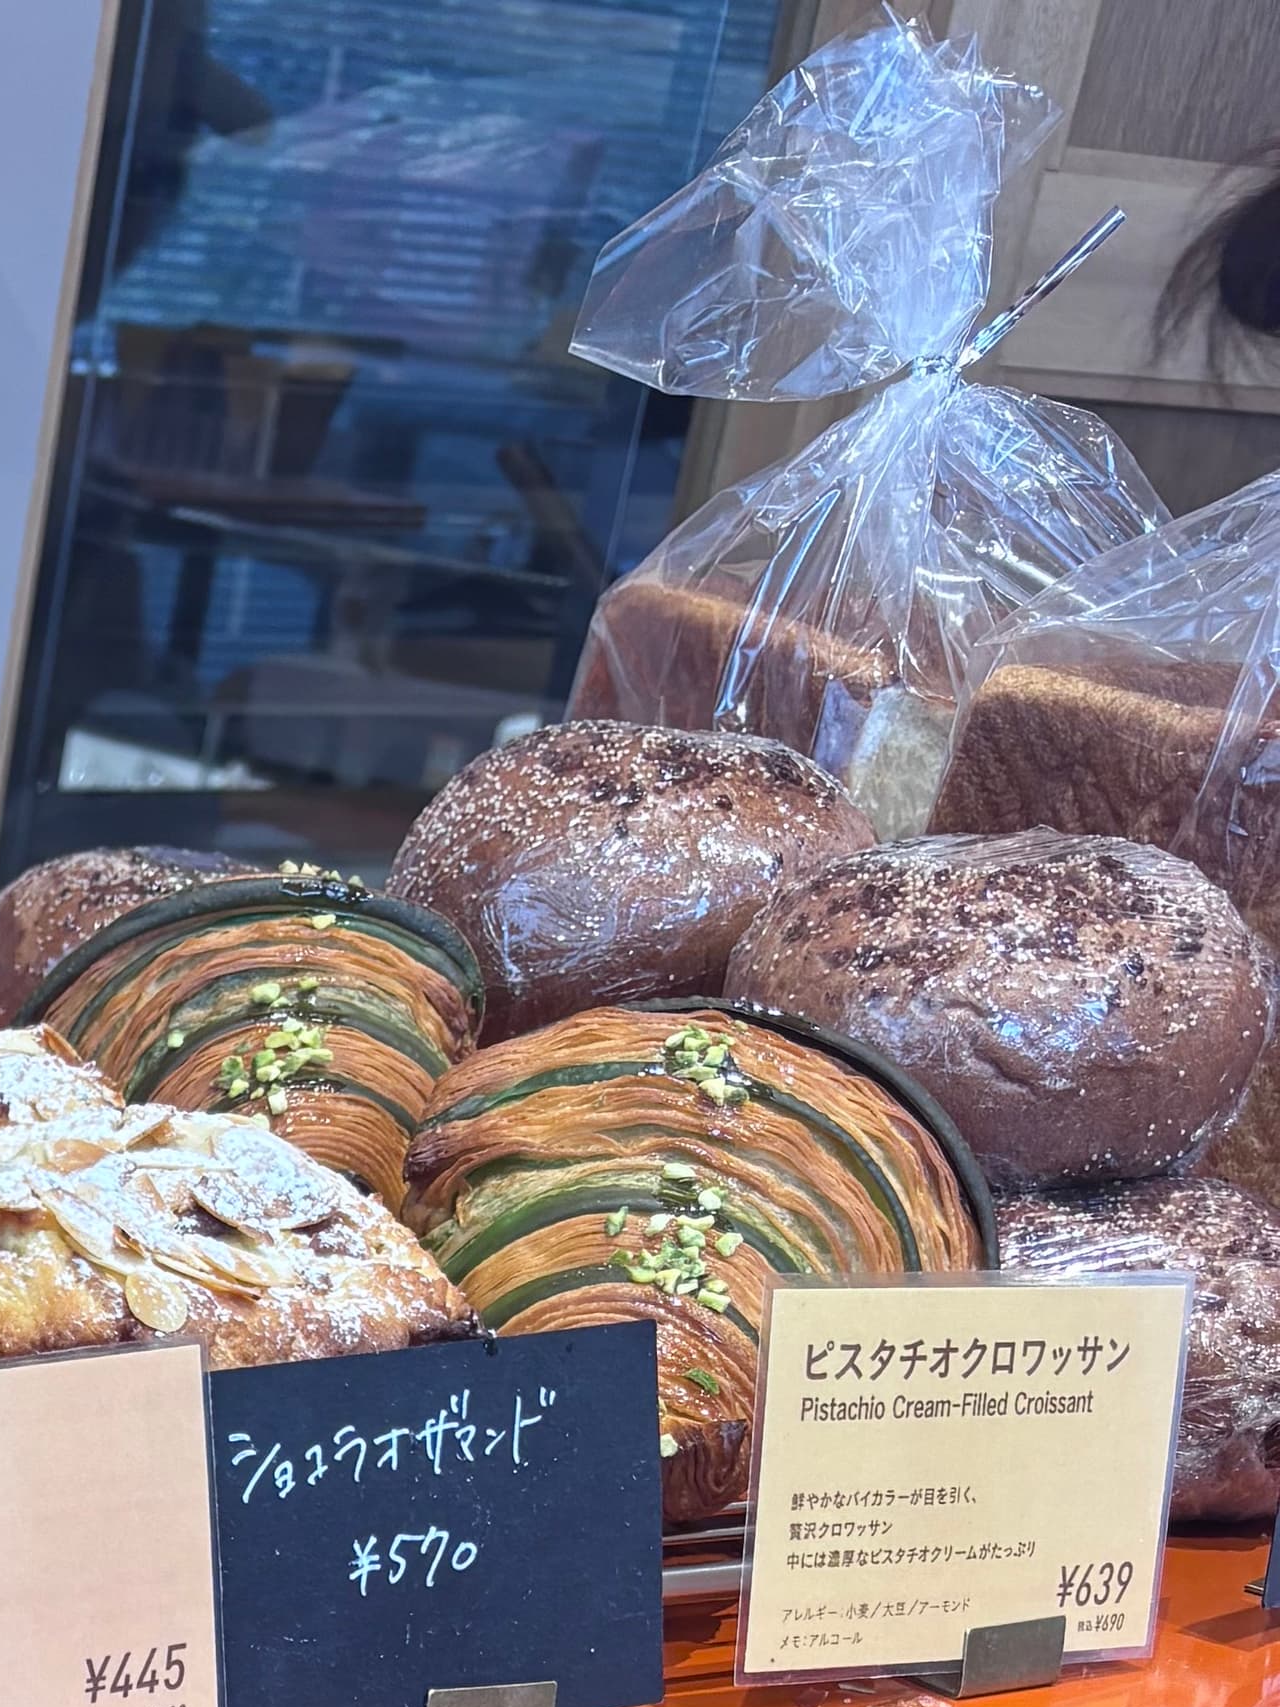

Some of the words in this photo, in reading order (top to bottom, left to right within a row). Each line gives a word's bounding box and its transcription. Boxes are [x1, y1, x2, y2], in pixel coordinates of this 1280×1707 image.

[804, 1335, 1131, 1382] ピスタチオクロワッサン
[800, 1396, 886, 1422] Pistachio
[892, 1391, 1009, 1419] Cream-Filled
[1014, 1390, 1094, 1416] Croissant
[789, 1520, 894, 1541] 贅沢クロワッサン
[348, 1525, 478, 1597] ¥570
[786, 1540, 1036, 1570] 中には濃厚なピスタチオクリームがたっぷり
[1056, 1562, 1134, 1609] ¥639
[84, 1642, 188, 1704] ¥445
